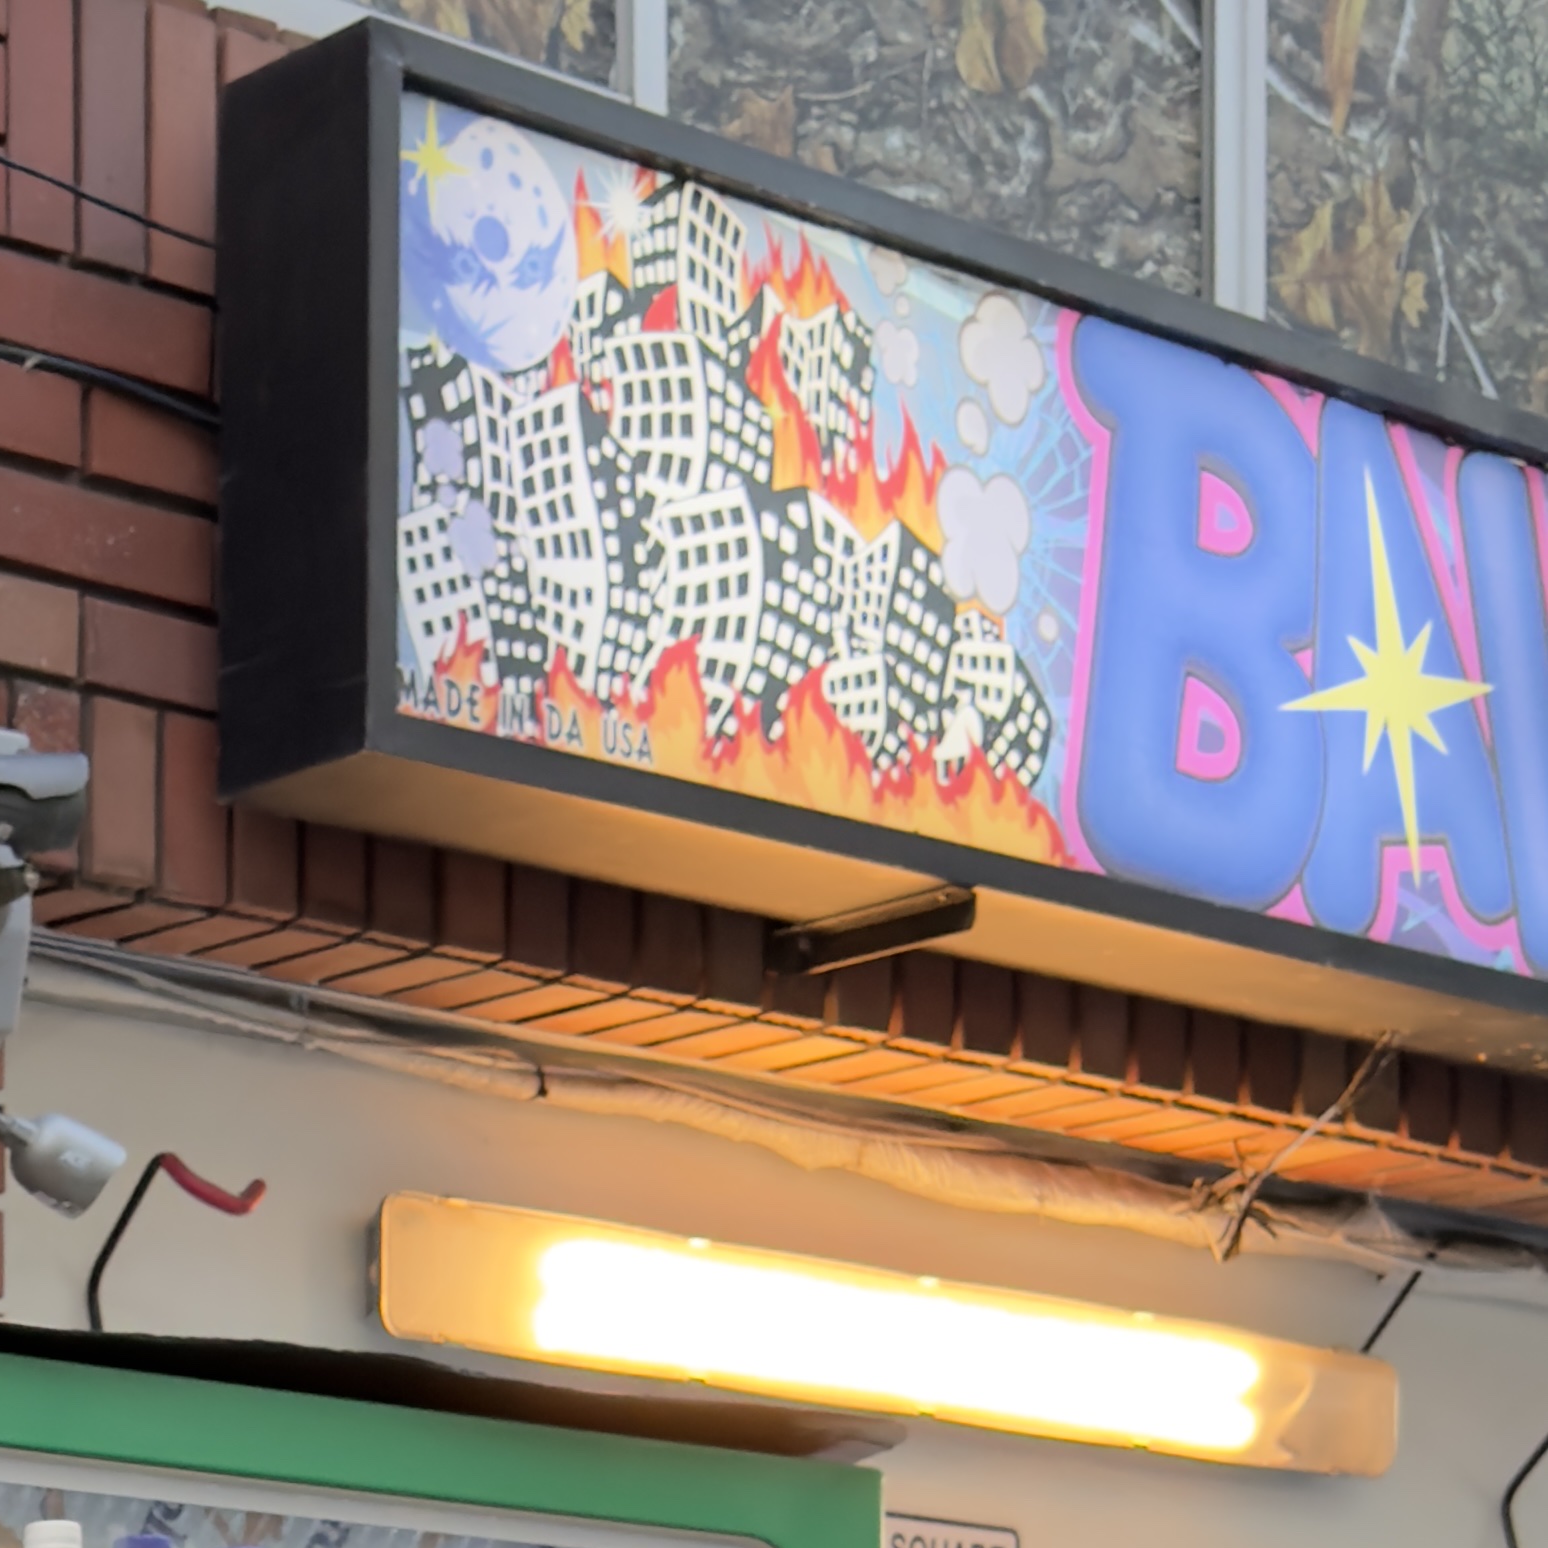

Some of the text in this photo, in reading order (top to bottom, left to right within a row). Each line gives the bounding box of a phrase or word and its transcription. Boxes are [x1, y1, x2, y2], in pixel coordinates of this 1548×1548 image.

[396, 668, 654, 765] MADE IN DA USA
